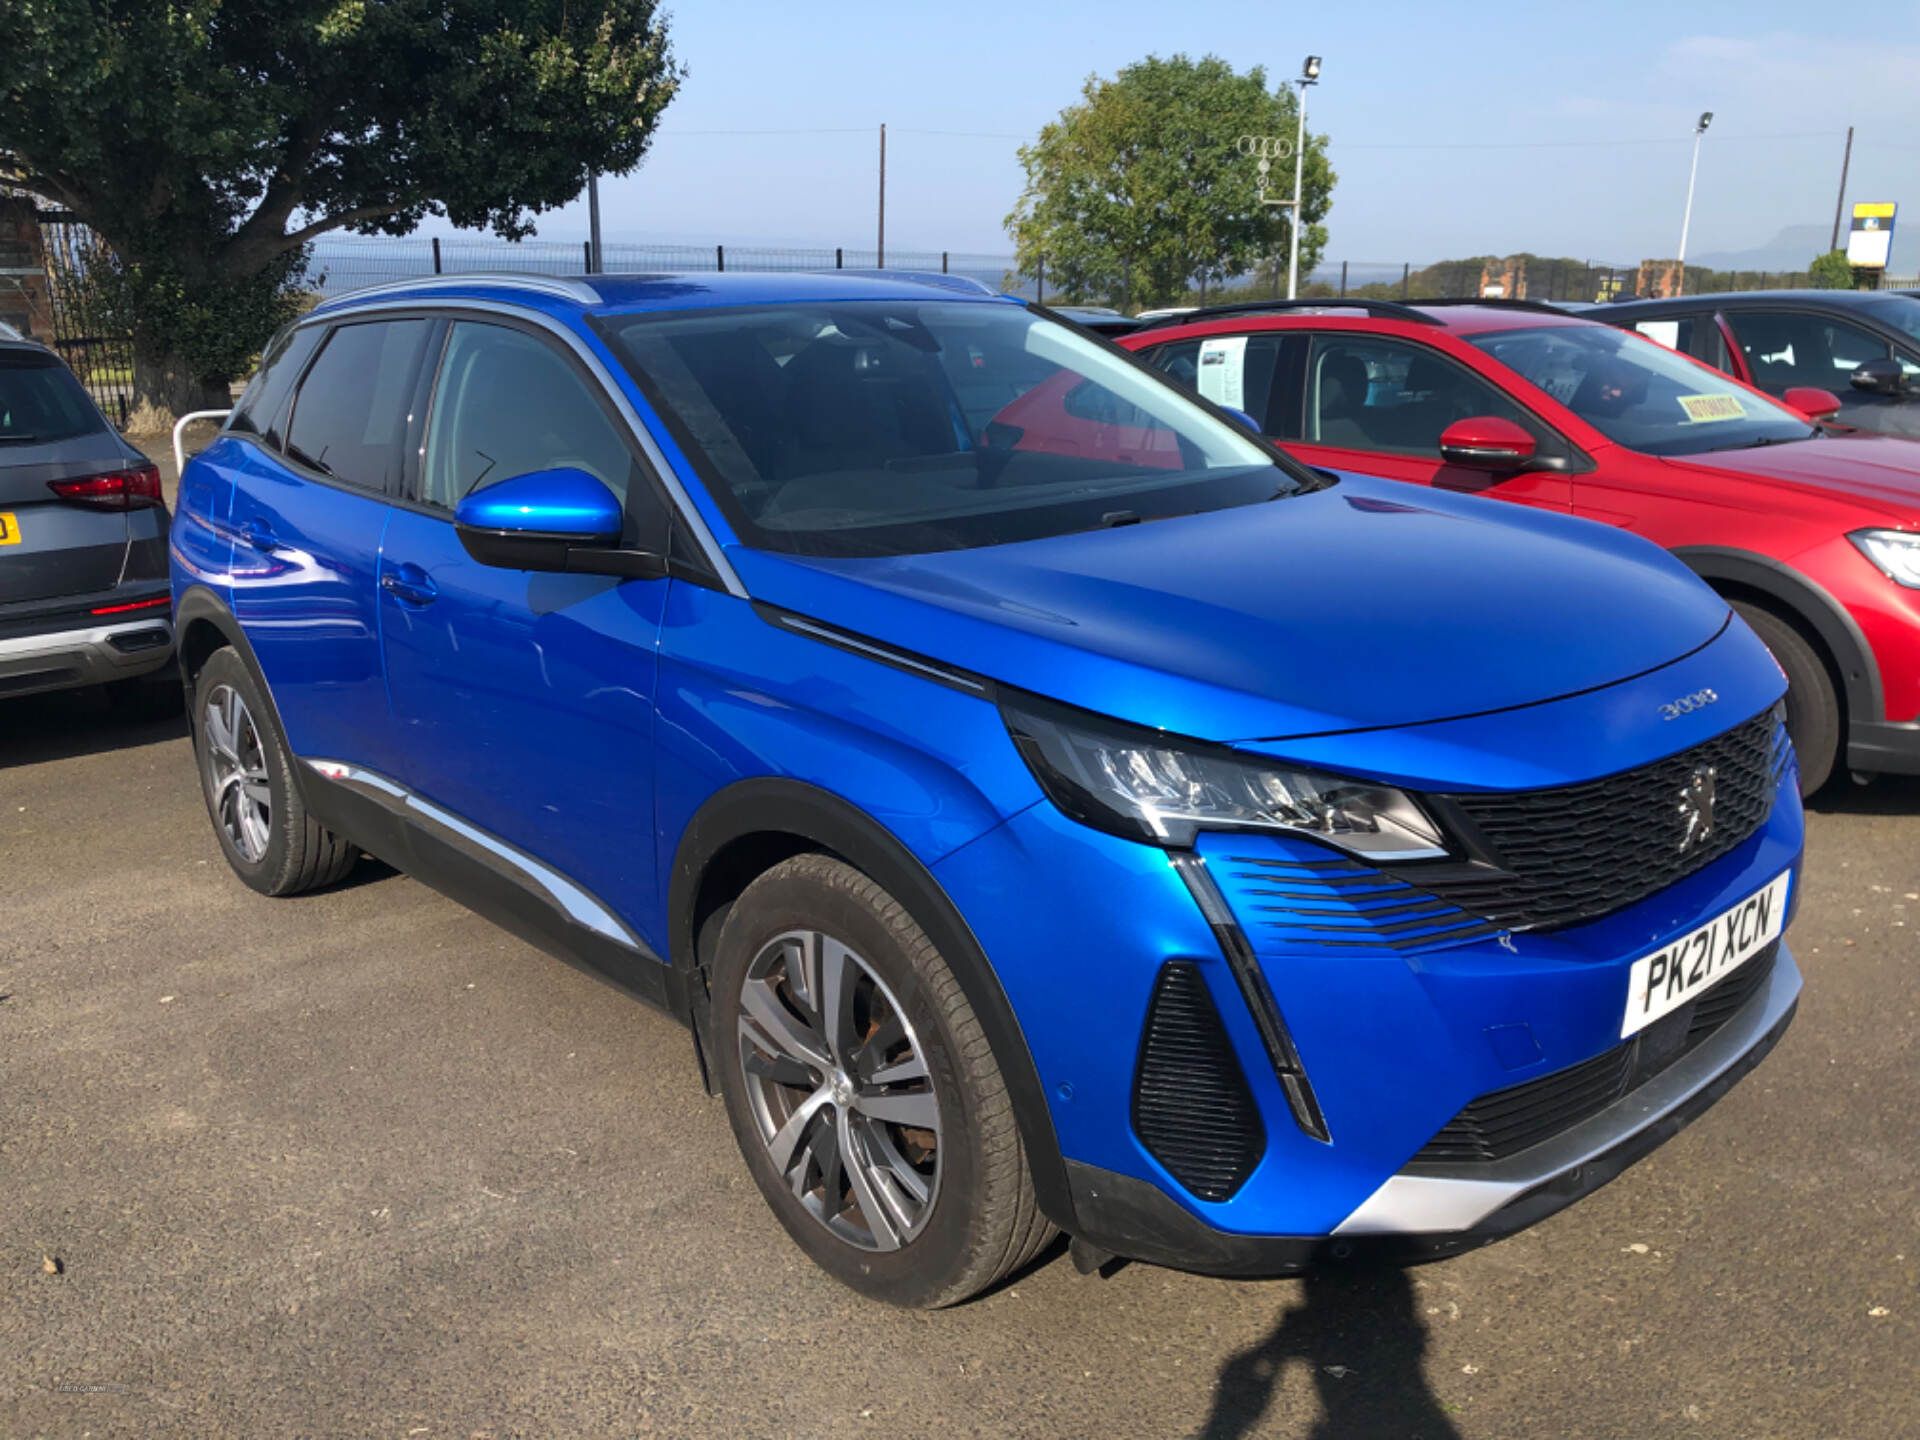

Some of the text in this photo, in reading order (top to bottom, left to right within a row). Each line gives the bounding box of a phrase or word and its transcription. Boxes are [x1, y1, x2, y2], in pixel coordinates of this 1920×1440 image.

[1656, 688, 1718, 721] 3008
[1643, 886, 1774, 1013] PK21 XCN
